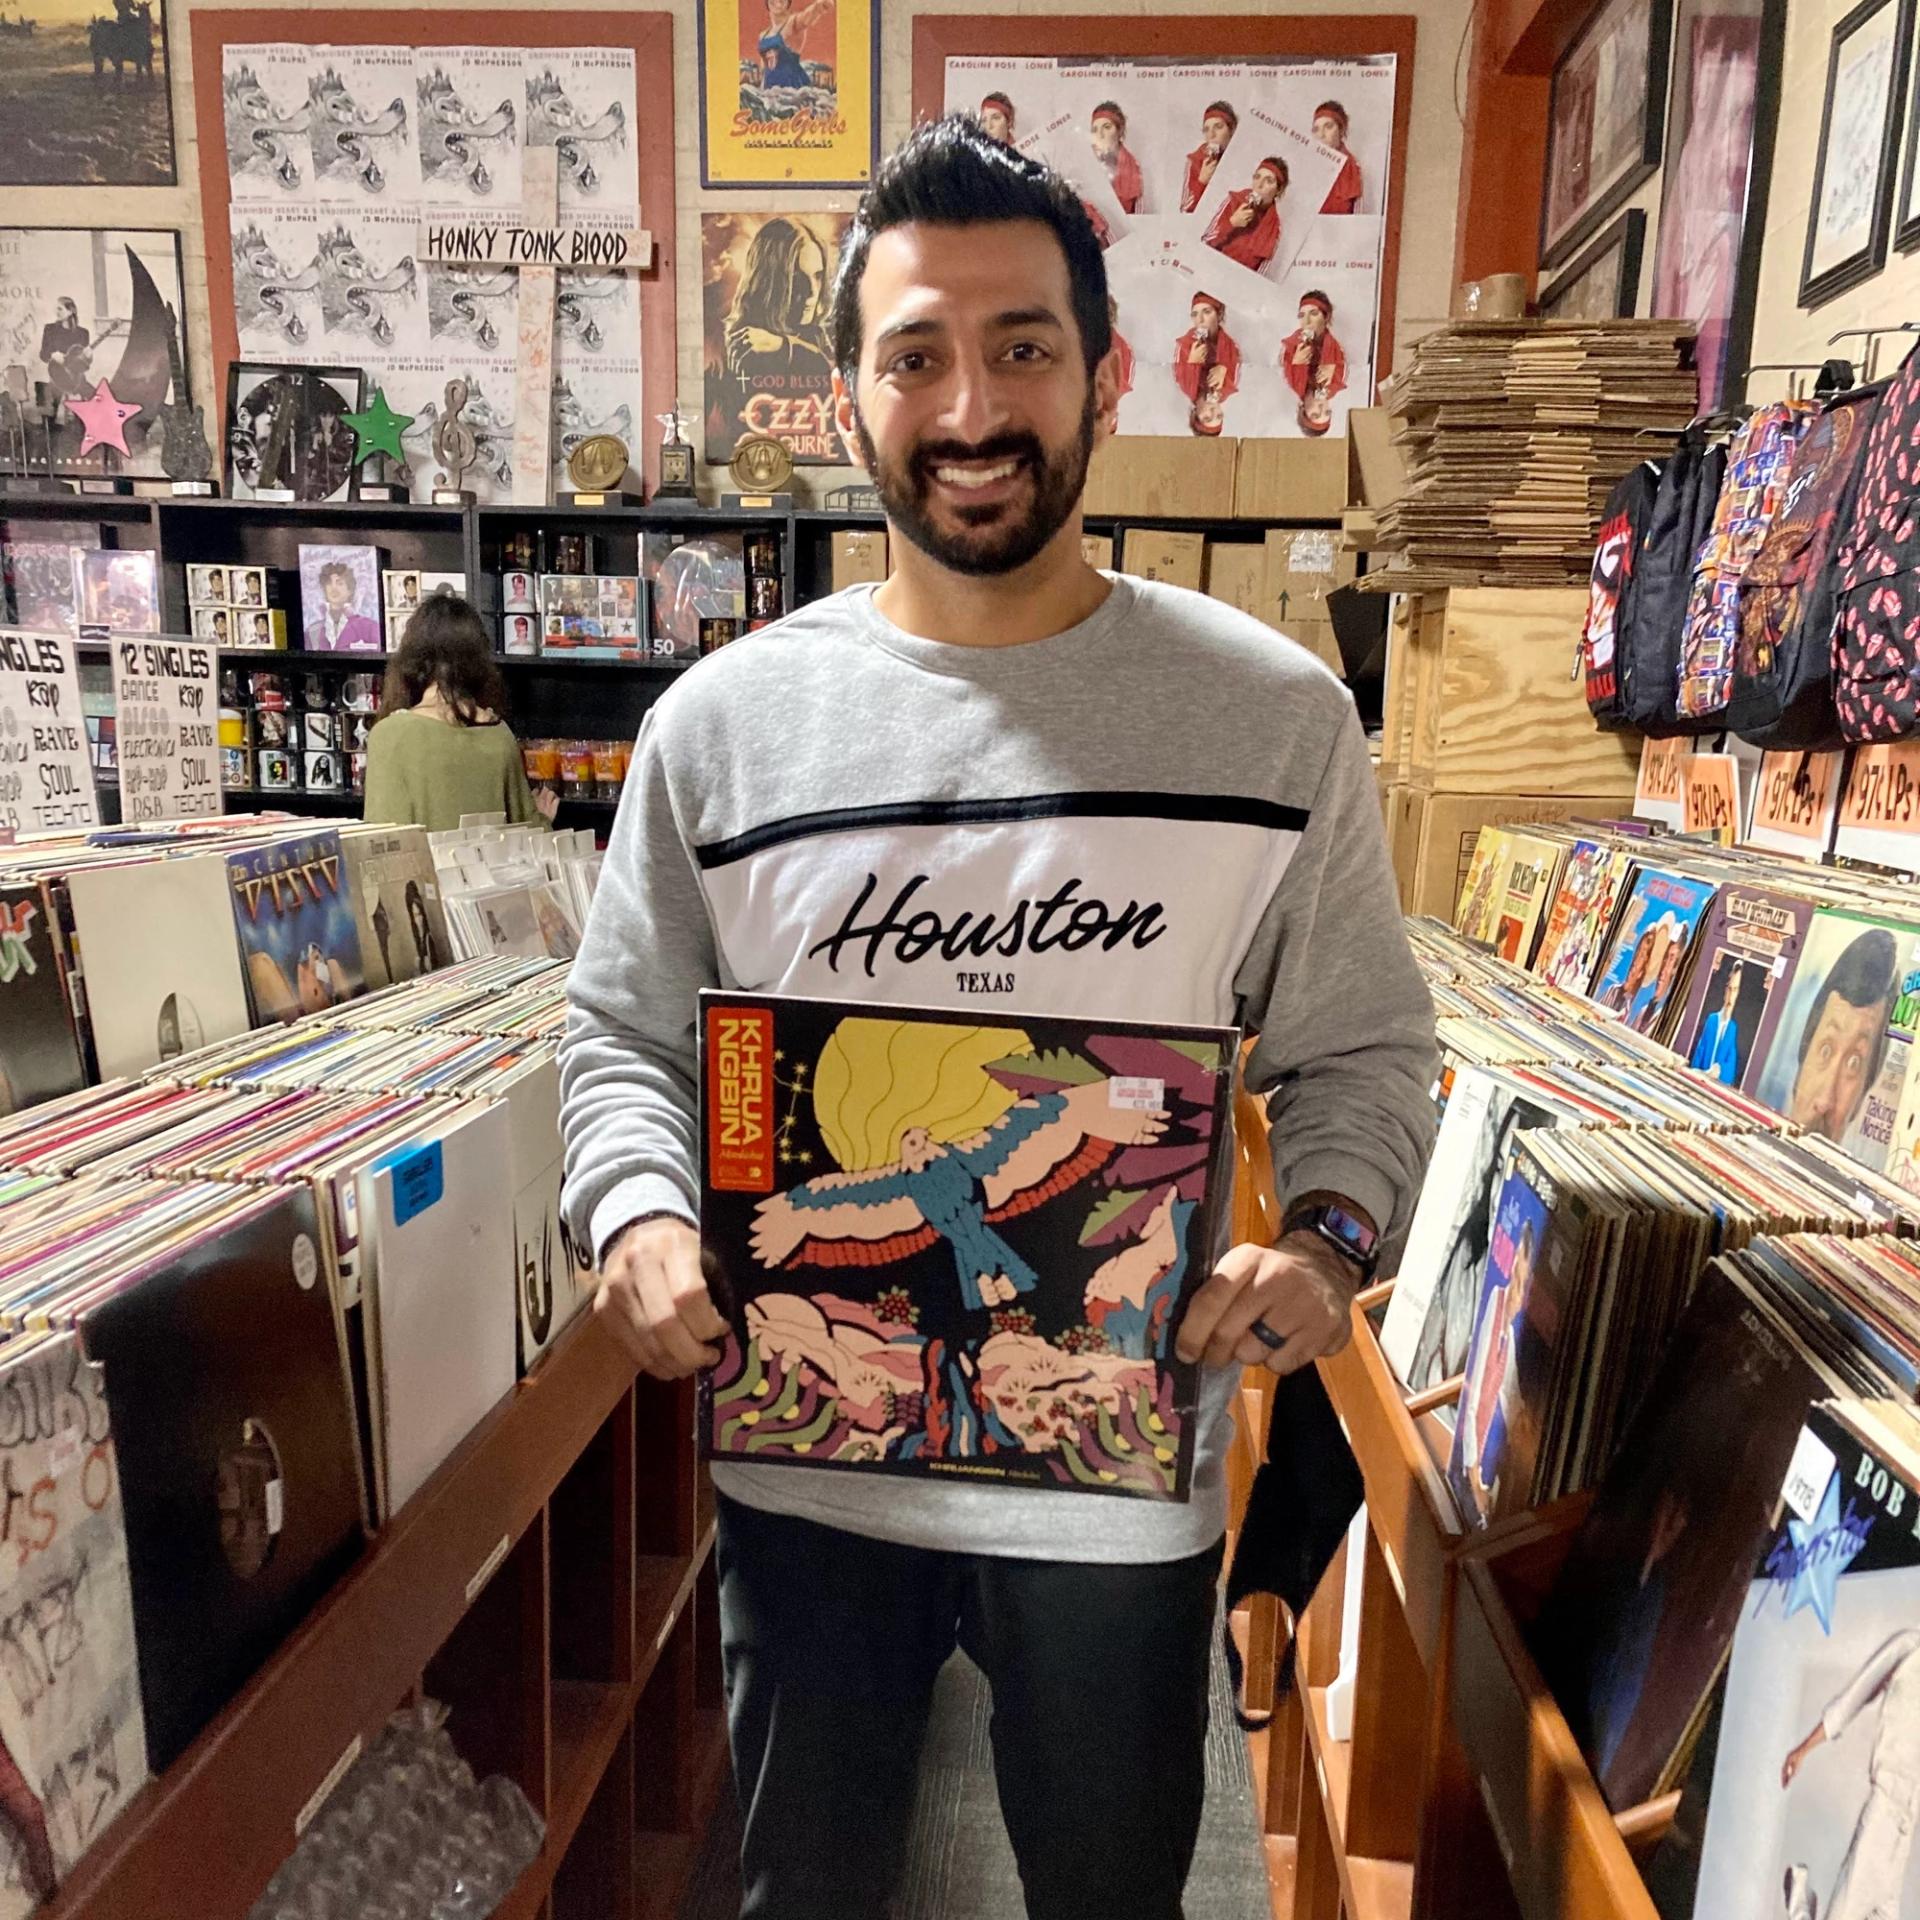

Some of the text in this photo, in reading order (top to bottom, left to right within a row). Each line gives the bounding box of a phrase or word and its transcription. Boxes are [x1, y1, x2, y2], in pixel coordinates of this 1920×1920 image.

[949, 61, 991, 69] CAROLINE
[1025, 62, 1053, 70] LONER
[1060, 70, 1102, 78] CAROLINE
[730, 106, 847, 145] Some Girls
[1020, 113, 1072, 150] ROSE LONER
[1250, 108, 1288, 135] CAROLINE
[1290, 131, 1310, 146] ROSE
[429, 226, 498, 261] HONKY
[506, 229, 567, 263] TONK
[1315, 260, 1337, 268] ROSE
[290, 375, 303, 385] 12
[752, 375, 784, 388] GOD
[738, 393, 834, 434] OZZY
[144, 644, 210, 679] SINGLES
[653, 638, 675, 655] 50
[121, 679, 159, 701] DANCE
[32, 726, 79, 751] RAVE
[180, 725, 212, 747] RAVE
[39, 763, 81, 800] SOUL
[182, 757, 211, 790] SOUL
[133, 796, 163, 820] R&B
[1711, 784, 1728, 826] LPs
[1885, 763, 1913, 822] LPs
[808, 872, 1168, 977] Houston
[956, 972, 1015, 993] TEXAS
[718, 1019, 740, 1146] NGBIN
[741, 1019, 763, 1145] KHRUA
[1868, 1095, 1896, 1130] Taking
[1860, 1118, 1891, 1144] Notice
[1855, 1453, 1906, 1517] BOB
